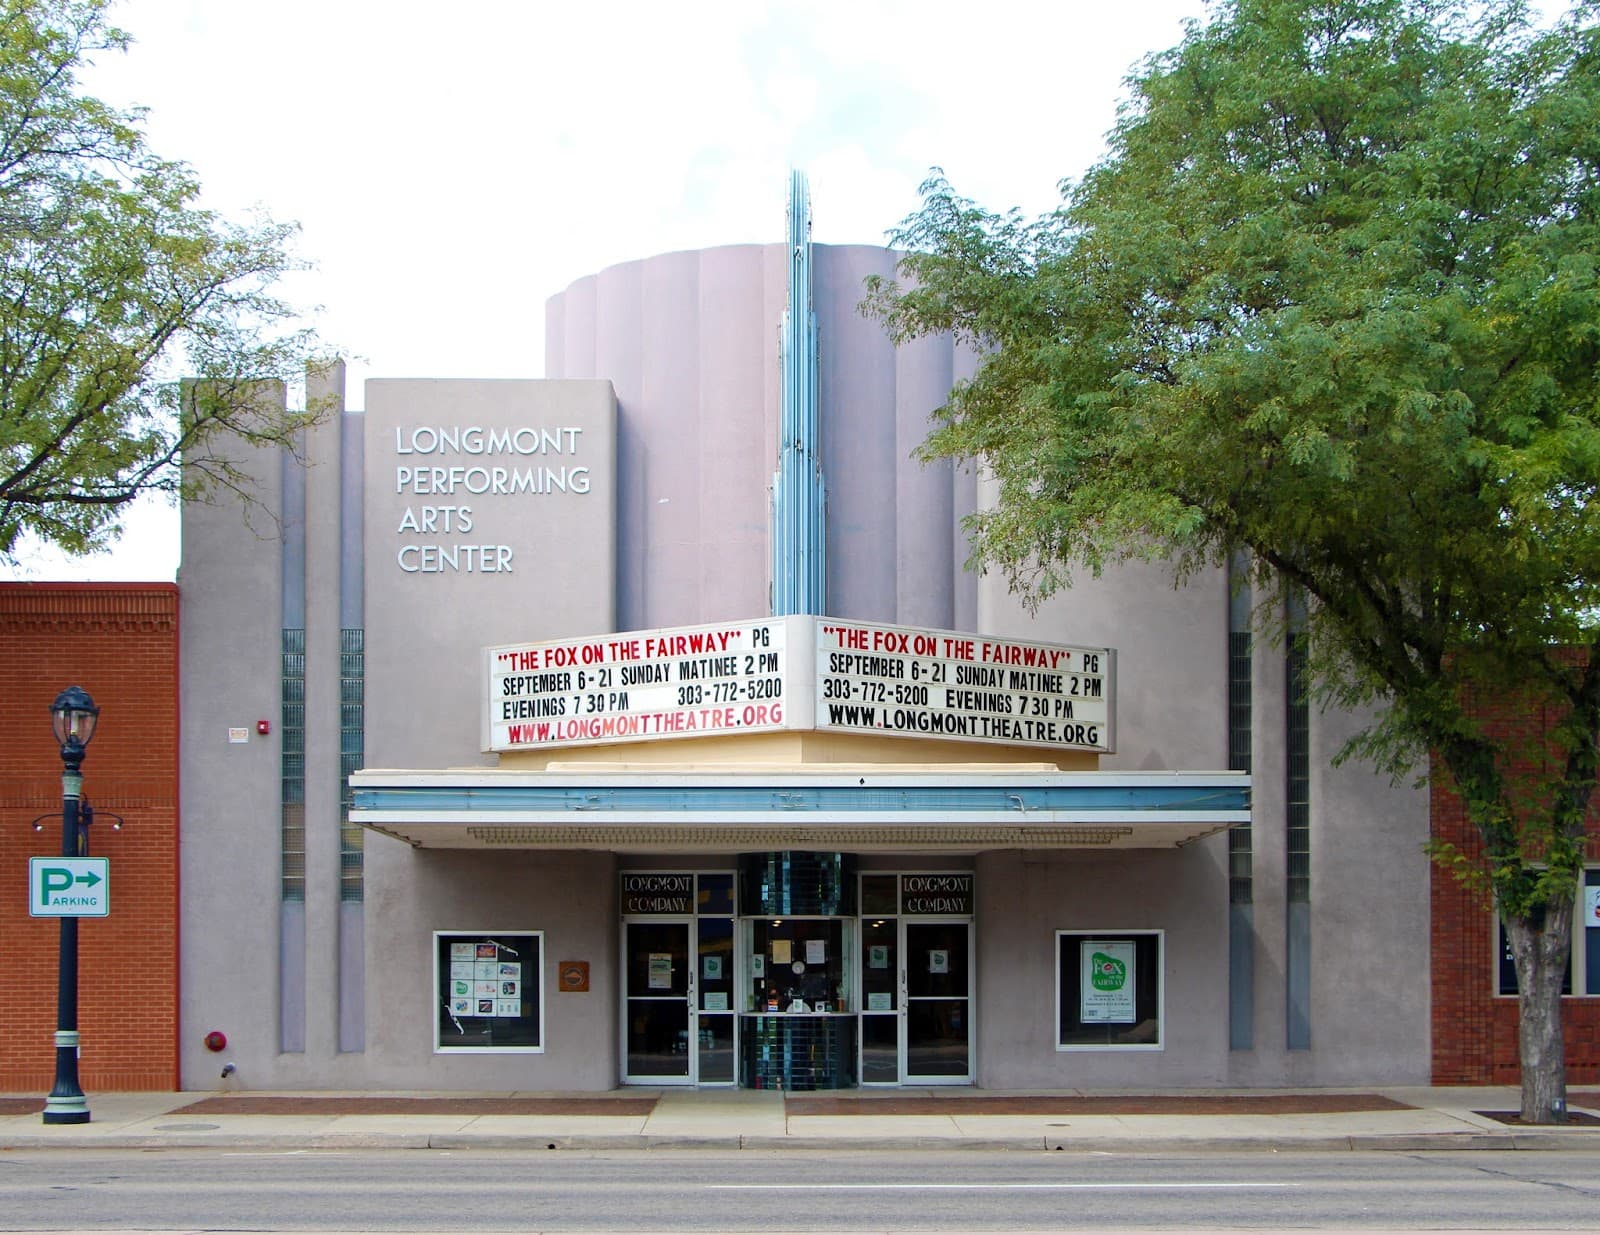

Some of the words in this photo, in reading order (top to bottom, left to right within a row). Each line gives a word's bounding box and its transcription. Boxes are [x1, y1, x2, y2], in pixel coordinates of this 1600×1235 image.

[396, 427, 582, 454] LONGMONT
[396, 467, 591, 494] PERFORMING
[398, 506, 473, 533] ARTS
[397, 545, 514, 572] CENTER
[545, 646, 577, 668] FOX
[582, 644, 603, 664] ON
[609, 639, 640, 661] THE
[752, 627, 770, 648] PG
[874, 631, 908, 654] FOX
[914, 635, 936, 657] ON
[943, 639, 974, 661] THE
[1083, 654, 1099, 673] PG
[503, 672, 571, 696] SEPTEMBER
[621, 663, 671, 686] SUNDAY
[679, 657, 738, 680] MATINEE
[744, 655, 754, 675] 2
[758, 652, 778, 673] PM
[830, 653, 904, 679] SEPTEMBER
[956, 665, 1005, 688] SUNDAY
[1010, 671, 1063, 694] MATINEE
[1070, 677, 1079, 695] 2
[1084, 678, 1101, 697] PM
[503, 697, 566, 720] EVENINGS
[574, 695, 581, 714] 7
[586, 694, 604, 713] 30
[609, 691, 629, 711] PM
[678, 677, 782, 706] 303-772-5200
[823, 678, 928, 706] 303-772-5200
[946, 689, 1012, 714] EVENINGS
[1019, 695, 1028, 715] 7
[1031, 698, 1049, 717] 30
[1055, 700, 1073, 719] PM
[508, 702, 783, 744] WWW.LONGMONTTHEATRE.ORG
[829, 704, 1098, 744] WWW.LONGMONTTHEATRE.ORG
[624, 877, 691, 892] LONGMONT
[904, 877, 969, 892] LONGMONT
[628, 898, 687, 912] COMPANY
[908, 898, 966, 912] COMPANY
